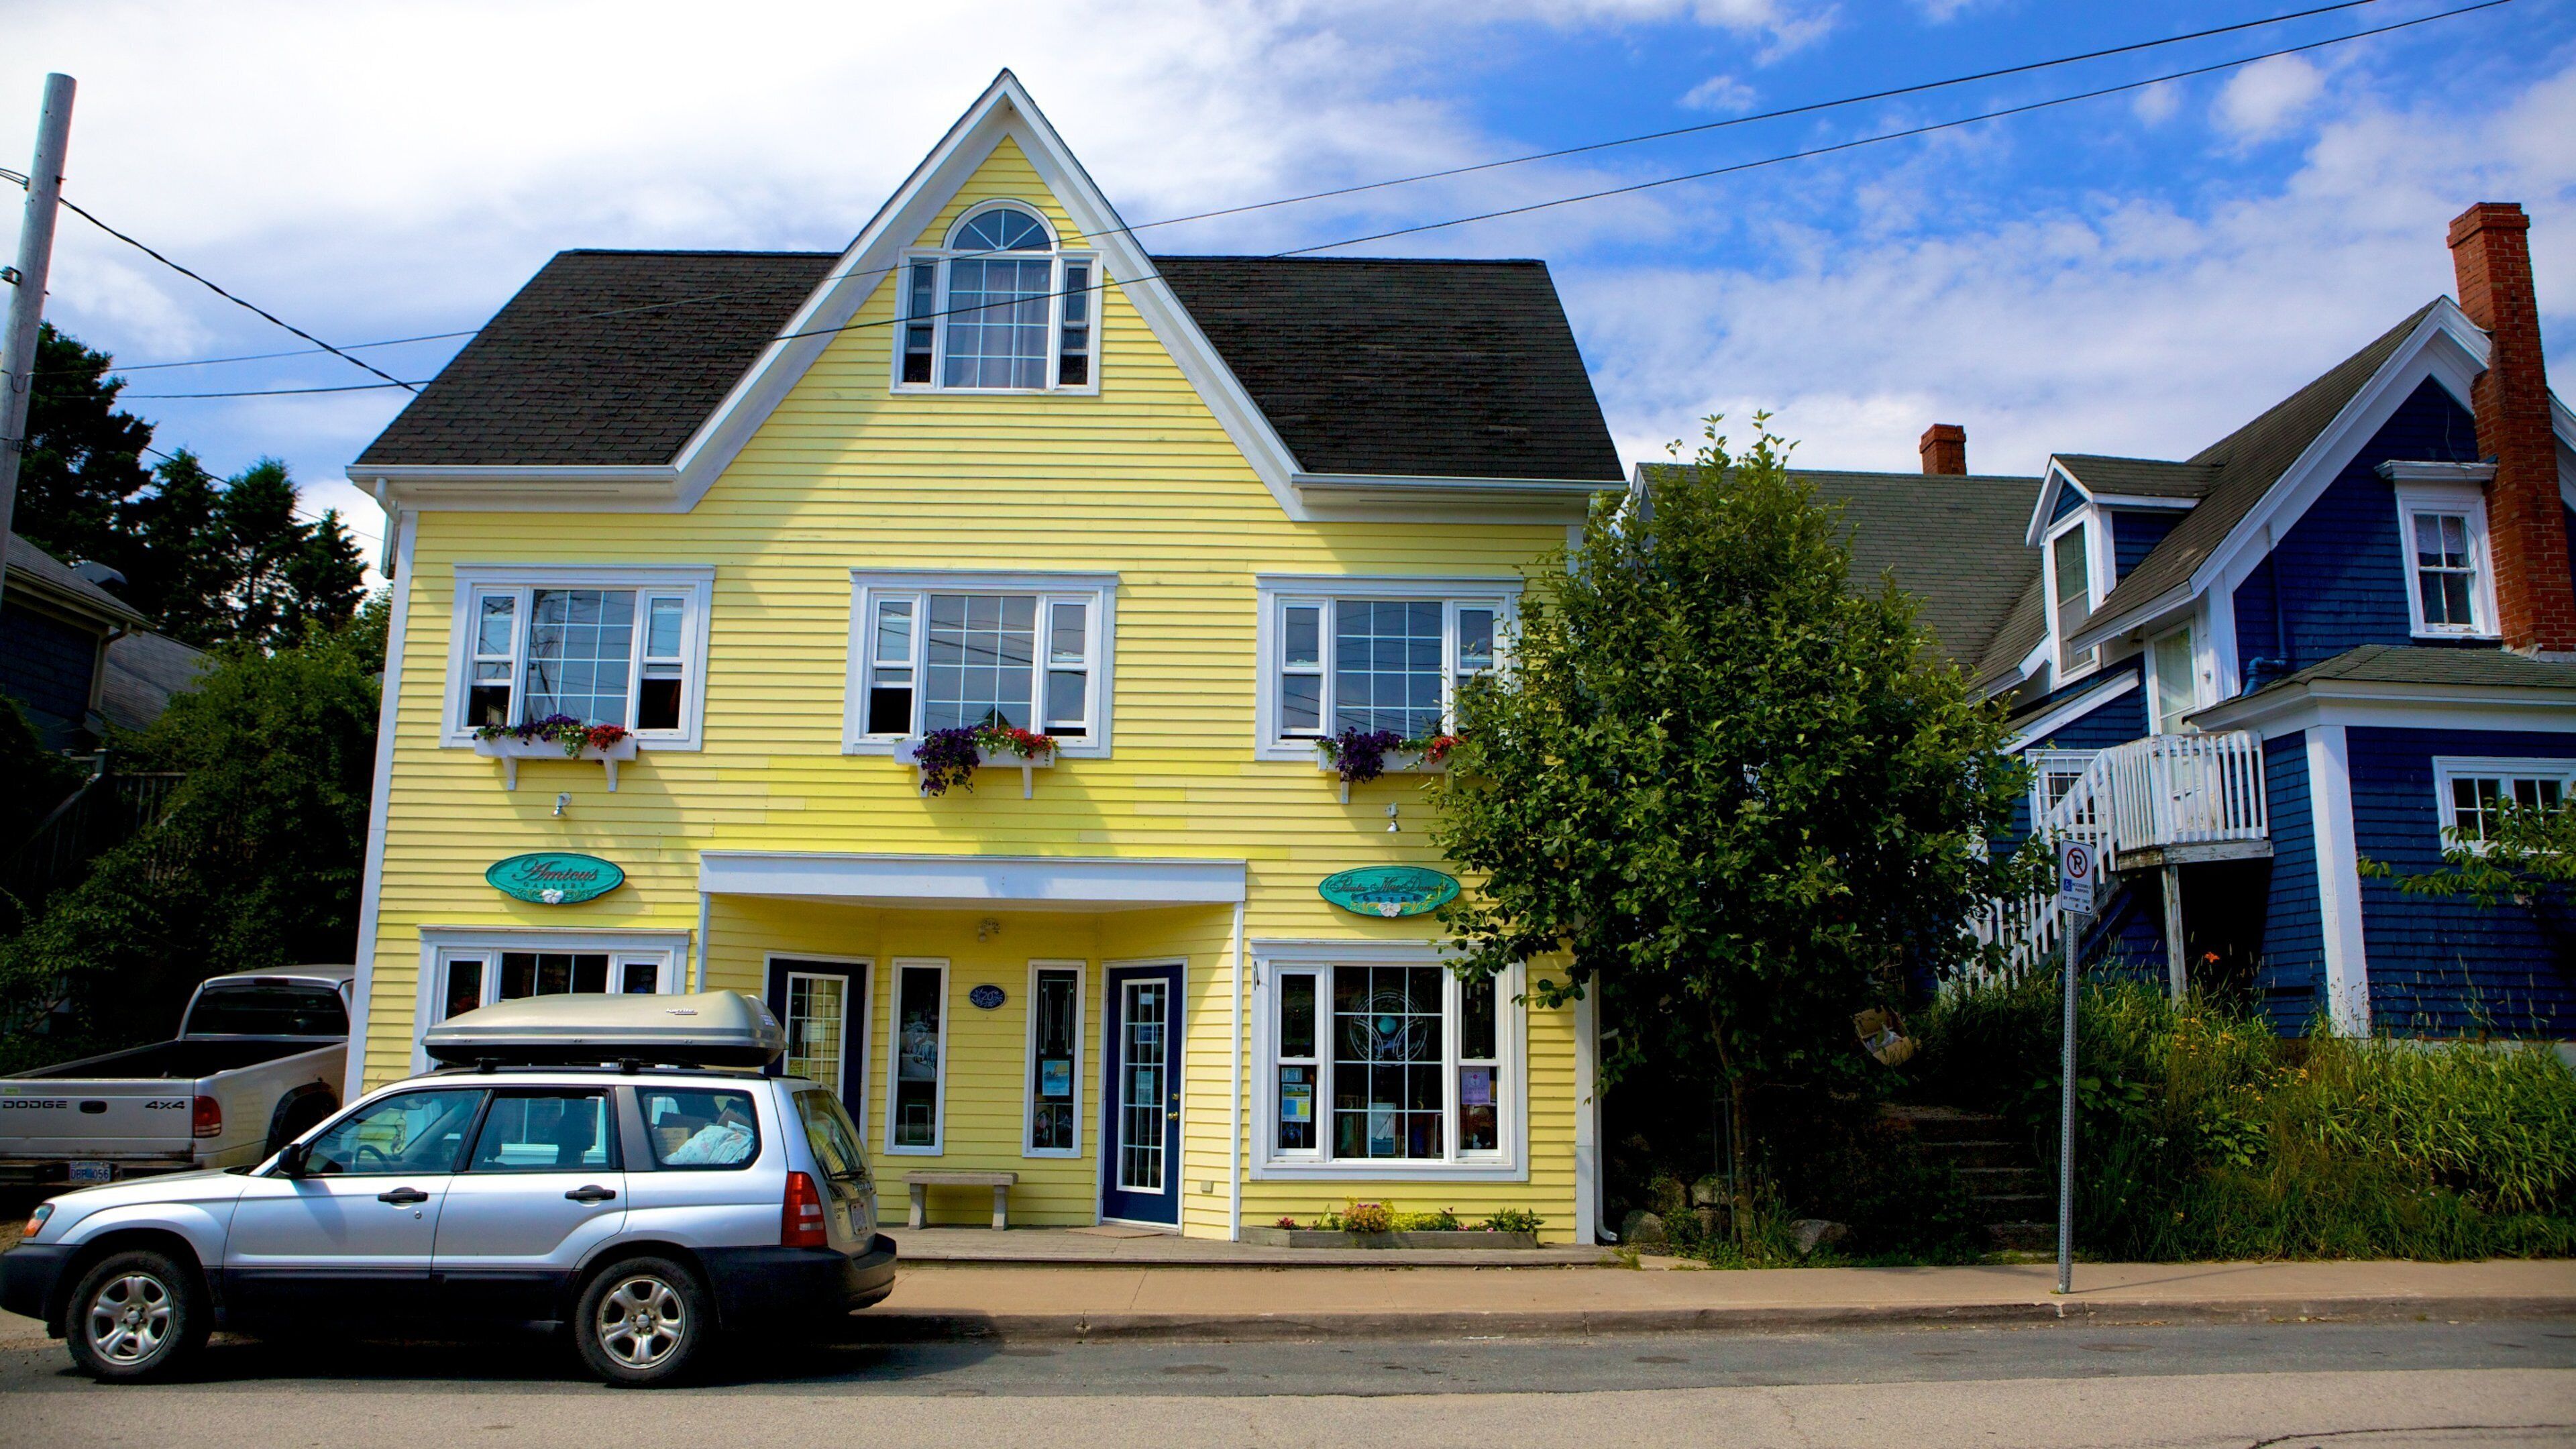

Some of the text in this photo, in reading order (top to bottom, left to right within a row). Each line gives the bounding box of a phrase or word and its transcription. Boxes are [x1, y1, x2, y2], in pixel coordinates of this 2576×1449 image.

[512, 858, 598, 881] Amicus
[523, 881, 586, 890] GALLERY
[1351, 892, 1430, 902] POTTER
[3, 1100, 68, 1109] DODGE
